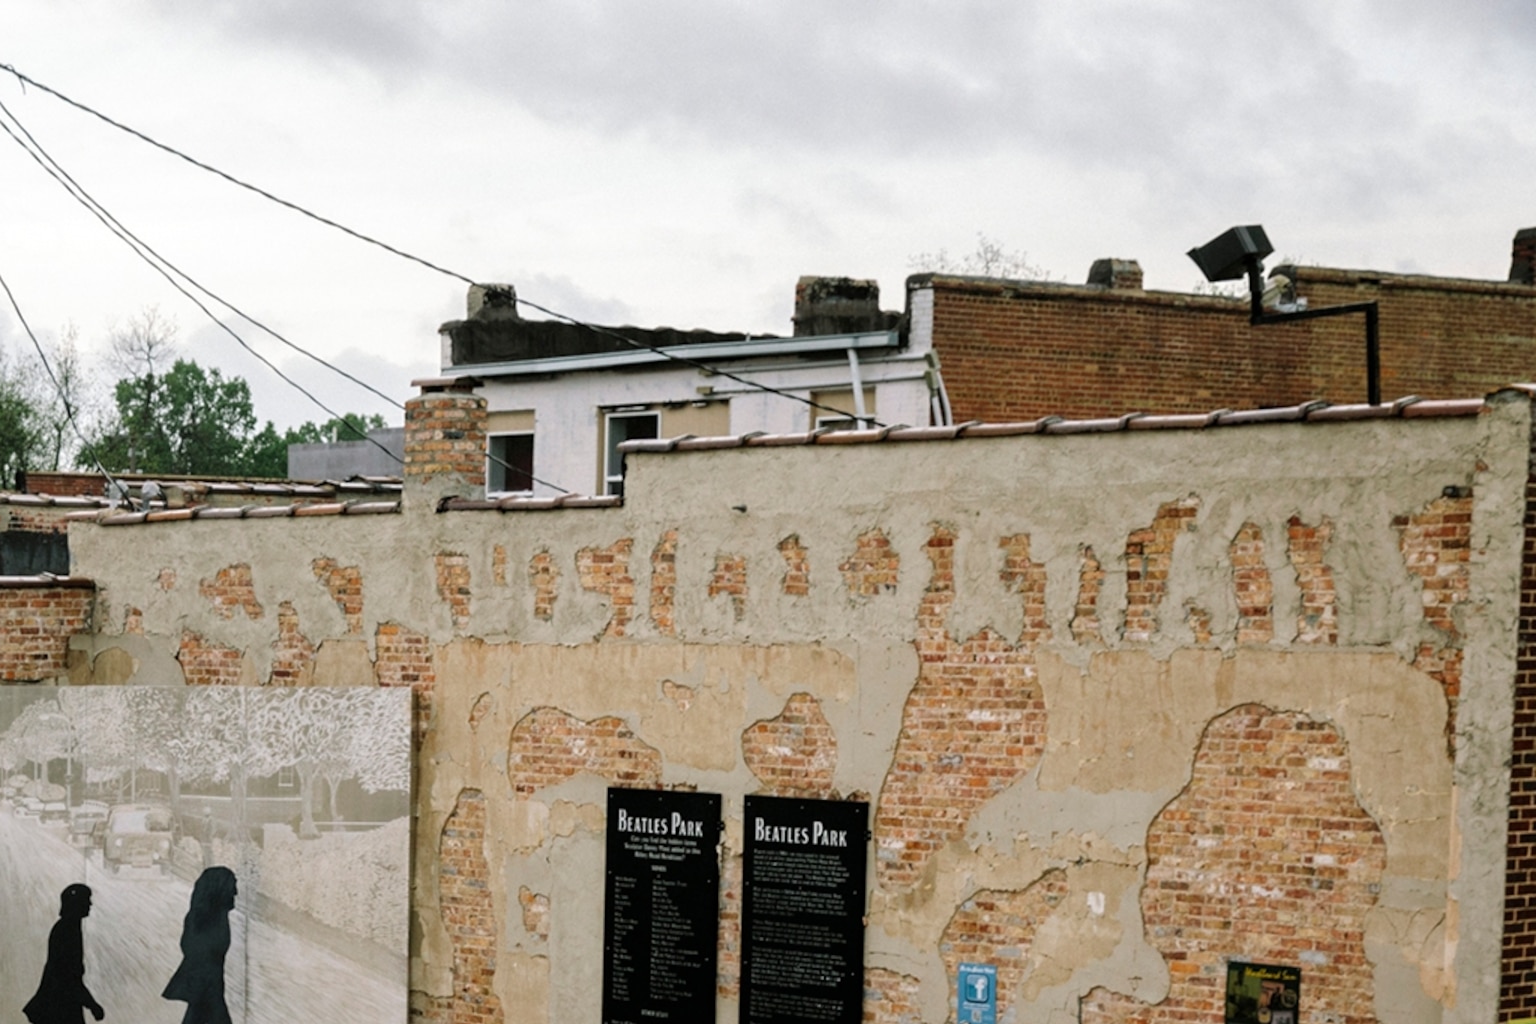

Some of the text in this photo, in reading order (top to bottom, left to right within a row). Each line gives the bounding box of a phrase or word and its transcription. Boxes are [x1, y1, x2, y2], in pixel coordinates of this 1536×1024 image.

[618, 808, 703, 837] BEATLES PARK
[754, 817, 848, 847] BEATLES PARK
